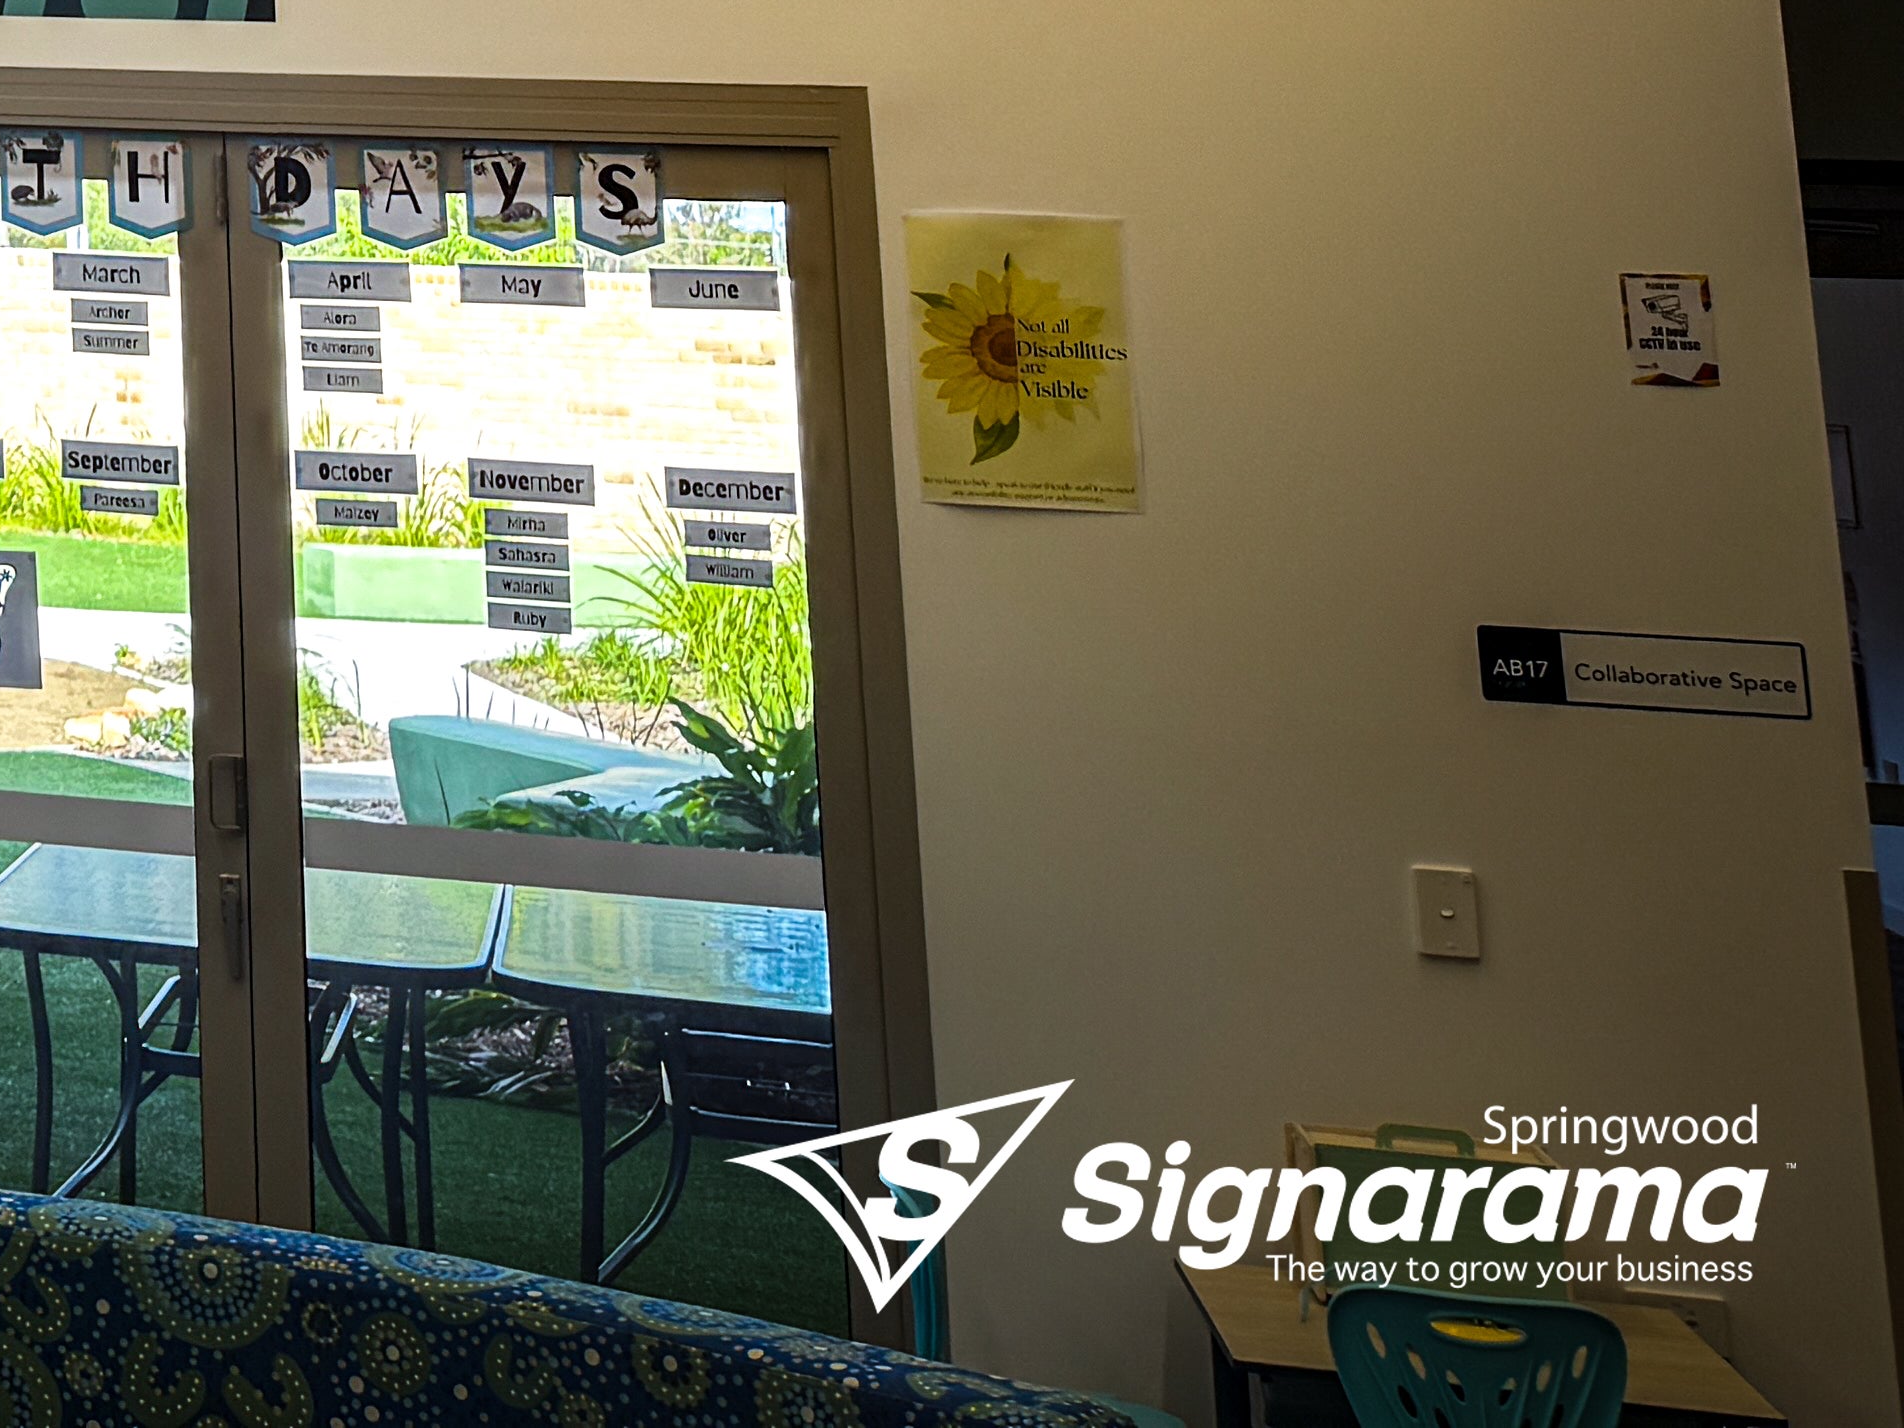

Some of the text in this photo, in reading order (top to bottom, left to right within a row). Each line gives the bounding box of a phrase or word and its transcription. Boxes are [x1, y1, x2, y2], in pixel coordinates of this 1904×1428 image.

[82, 263, 141, 285] March
[327, 271, 372, 294] April
[501, 274, 542, 299] May
[688, 279, 739, 300] June
[89, 306, 130, 320] Archer
[1018, 318, 1070, 334] Not all
[84, 335, 138, 349] Summer
[1017, 340, 1128, 361] Disabilities
[1021, 362, 1047, 374] are
[327, 373, 360, 387] Liam
[1021, 380, 1089, 400] Visible
[67, 451, 172, 475] September
[318, 462, 393, 483] October
[480, 470, 585, 495] November
[679, 479, 784, 501] December
[708, 528, 746, 543] Oliver
[498, 547, 555, 563] Sahasra
[706, 563, 754, 579] William
[514, 612, 547, 628] Ruby
[1493, 658, 1797, 696] AB17 Collaborative Space
